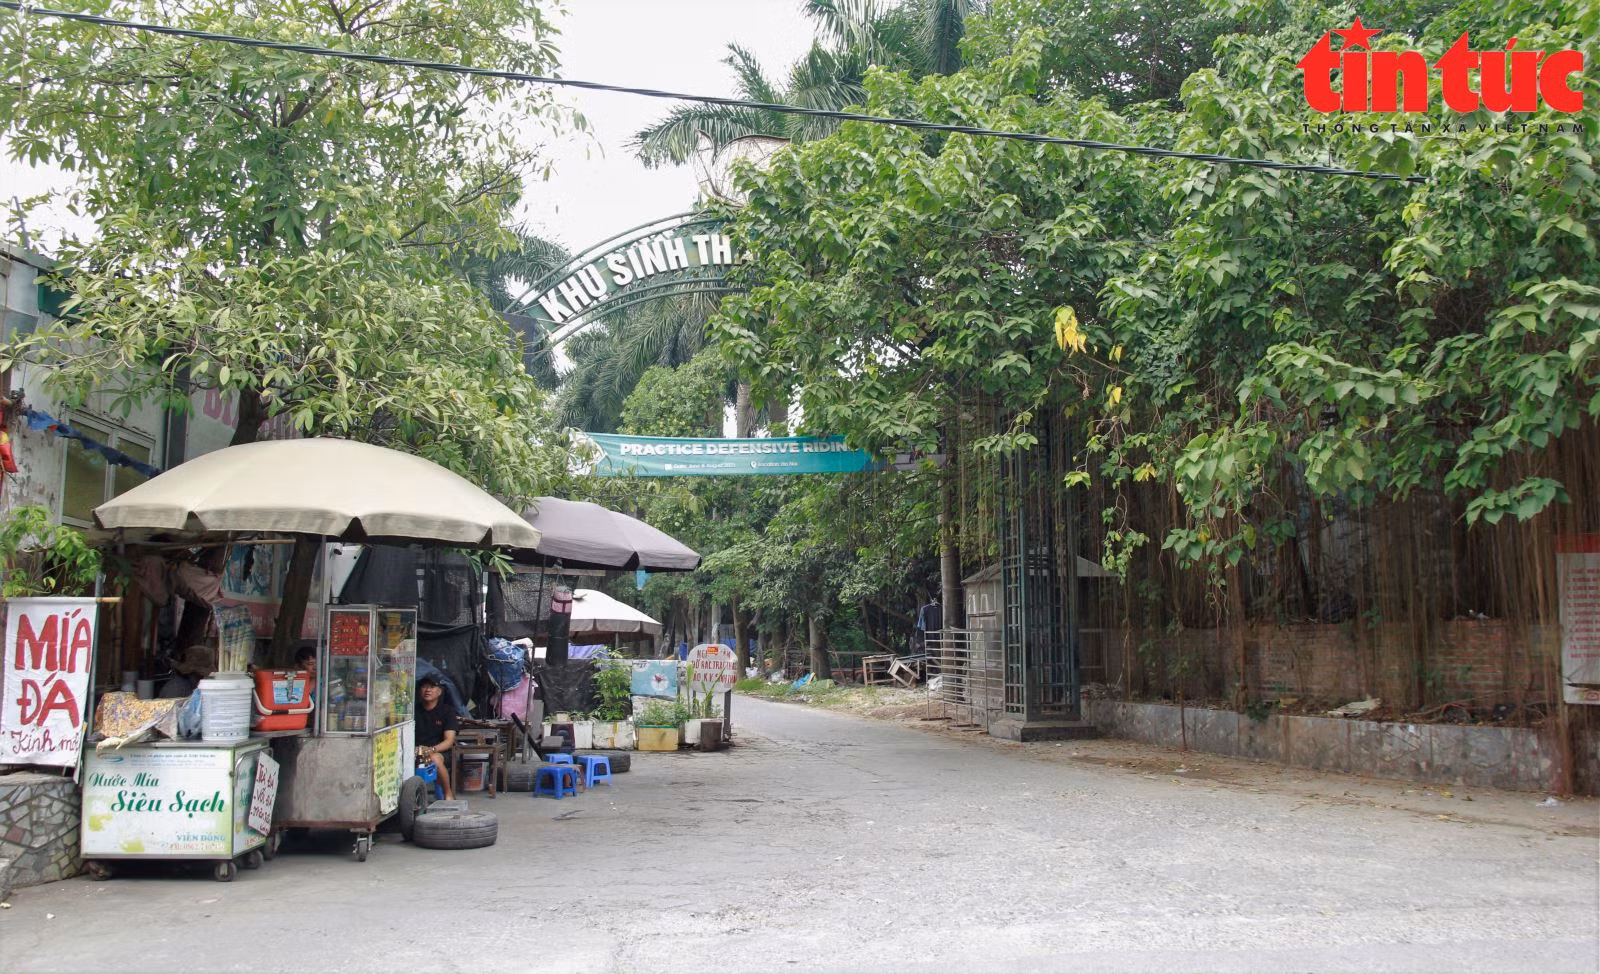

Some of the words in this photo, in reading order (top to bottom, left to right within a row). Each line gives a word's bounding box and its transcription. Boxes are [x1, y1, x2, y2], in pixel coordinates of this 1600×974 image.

[538, 263, 608, 324] KHU
[607, 236, 688, 286] SINH
[620, 443, 704, 456] PRACTICE
[706, 442, 800, 455] DEFENSIVE
[15, 608, 92, 673] MÍA
[16, 672, 80, 729] ĐÁ
[110, 789, 163, 813] Siêu
[168, 789, 225, 819] Sạch
